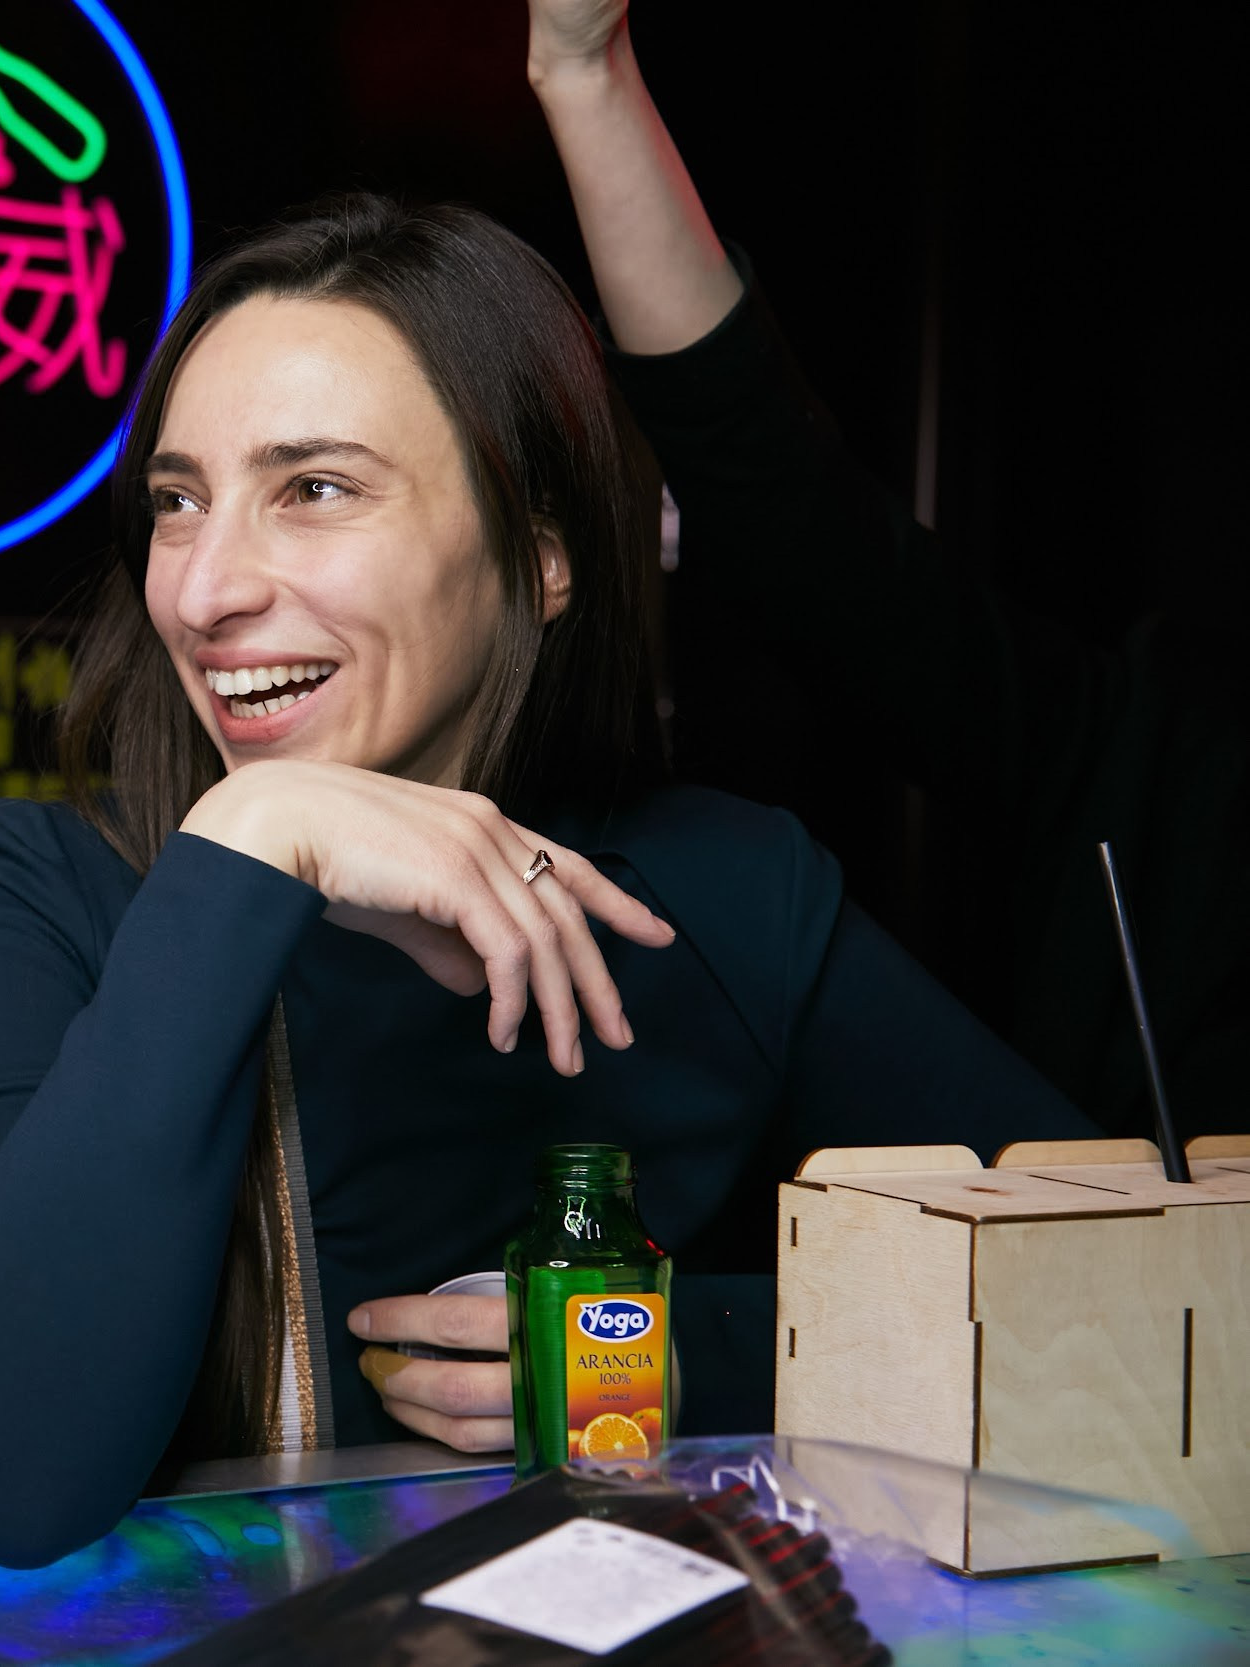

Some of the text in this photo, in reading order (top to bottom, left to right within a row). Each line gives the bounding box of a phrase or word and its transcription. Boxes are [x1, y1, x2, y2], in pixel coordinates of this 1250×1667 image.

[584, 1305, 645, 1337] Yoga
[576, 1353, 654, 1369] ARANCIA
[599, 1372, 632, 1385] 100%
[598, 1393, 631, 1401] ORANGE
